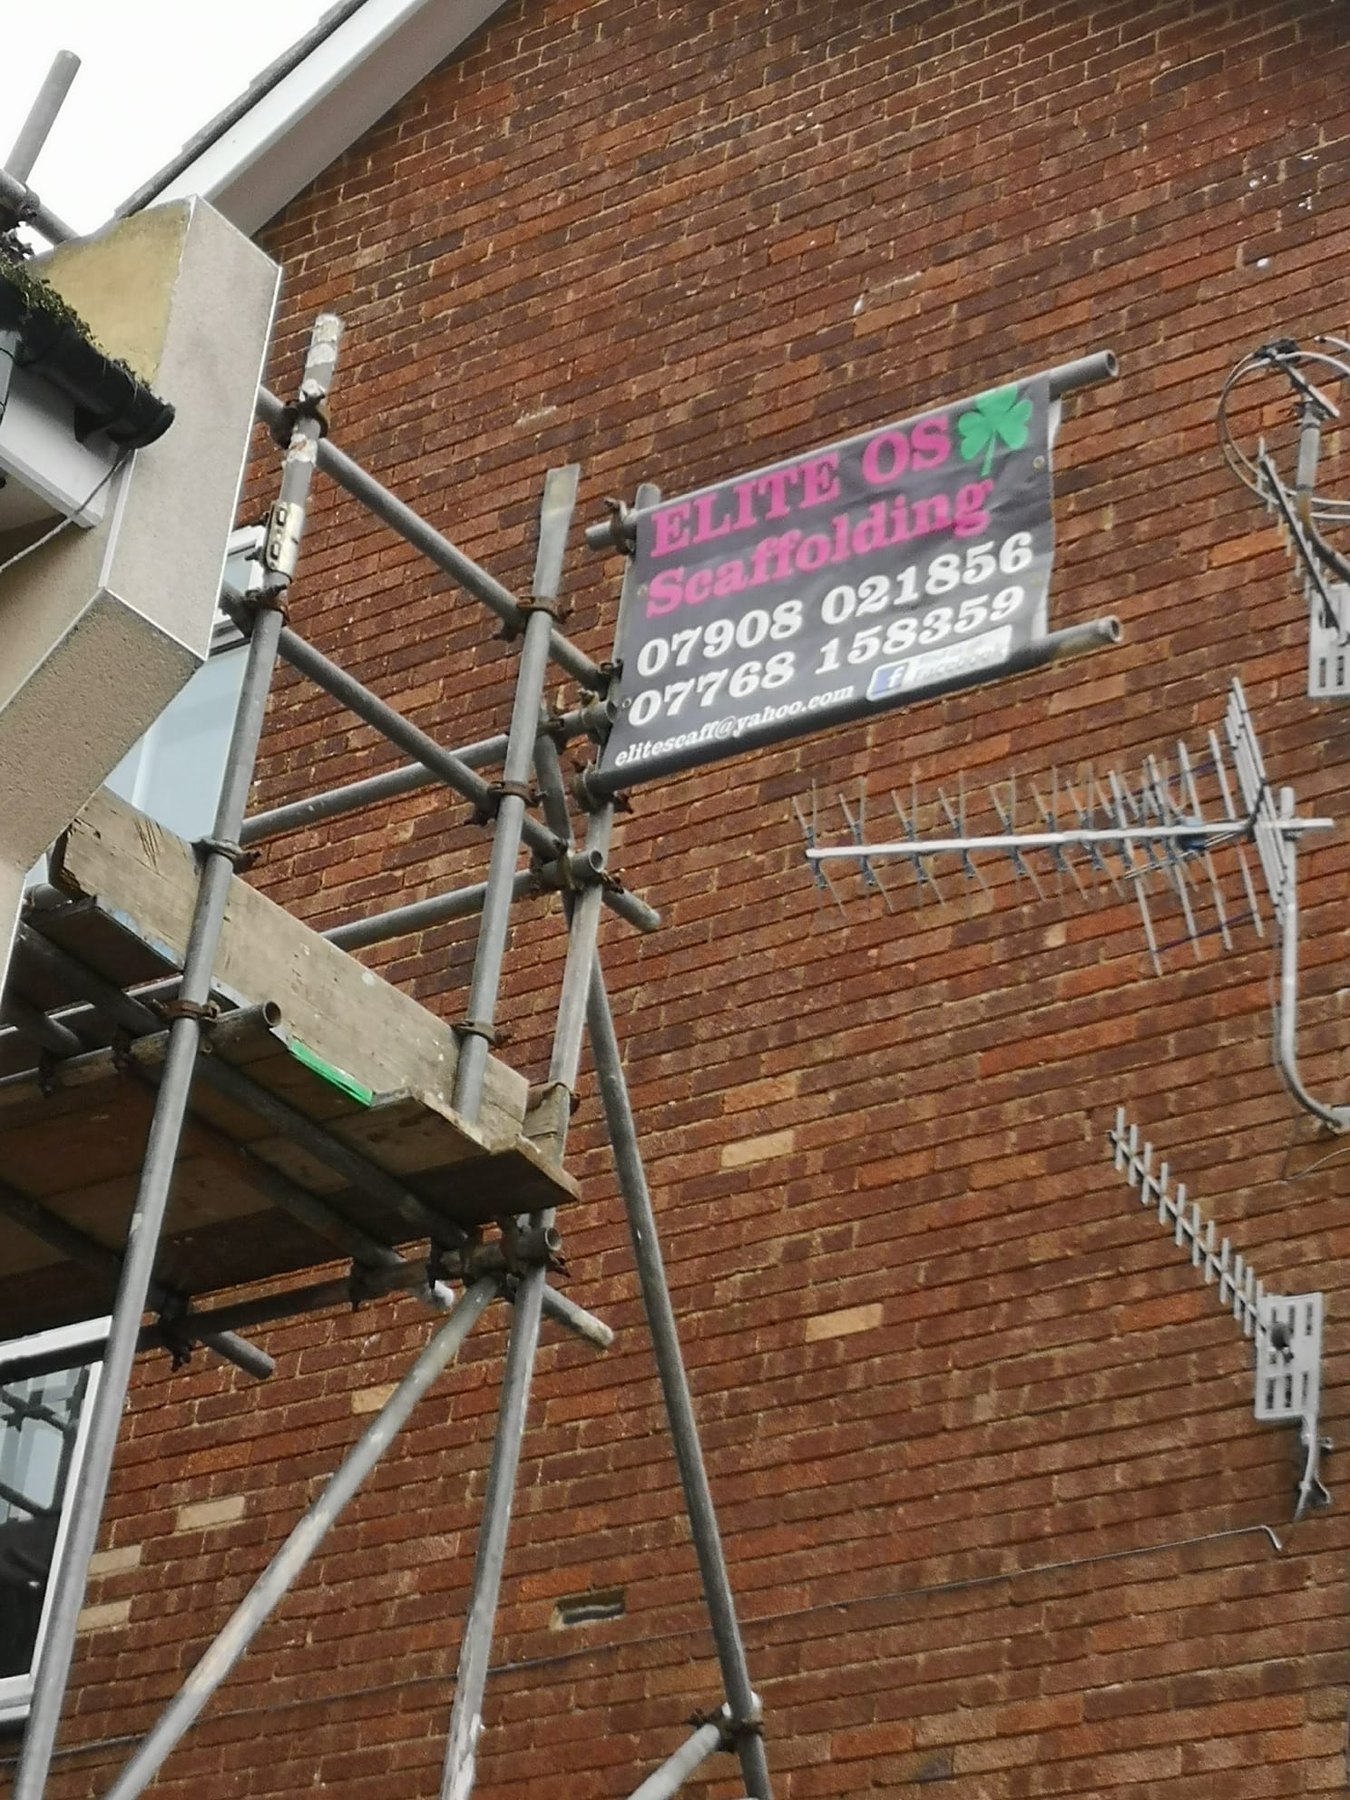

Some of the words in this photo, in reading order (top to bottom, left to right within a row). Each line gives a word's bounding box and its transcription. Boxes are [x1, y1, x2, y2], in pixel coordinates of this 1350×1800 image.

[646, 479, 994, 618] Scaffolding
[651, 454, 841, 557] ELITE
[862, 415, 952, 485] OS
[628, 651, 796, 726] 07768
[814, 586, 1025, 675] 158359
[637, 599, 803, 677] 07908
[821, 531, 1033, 626] 021856
[614, 686, 855, 767] elitescaff@yahoo.com
